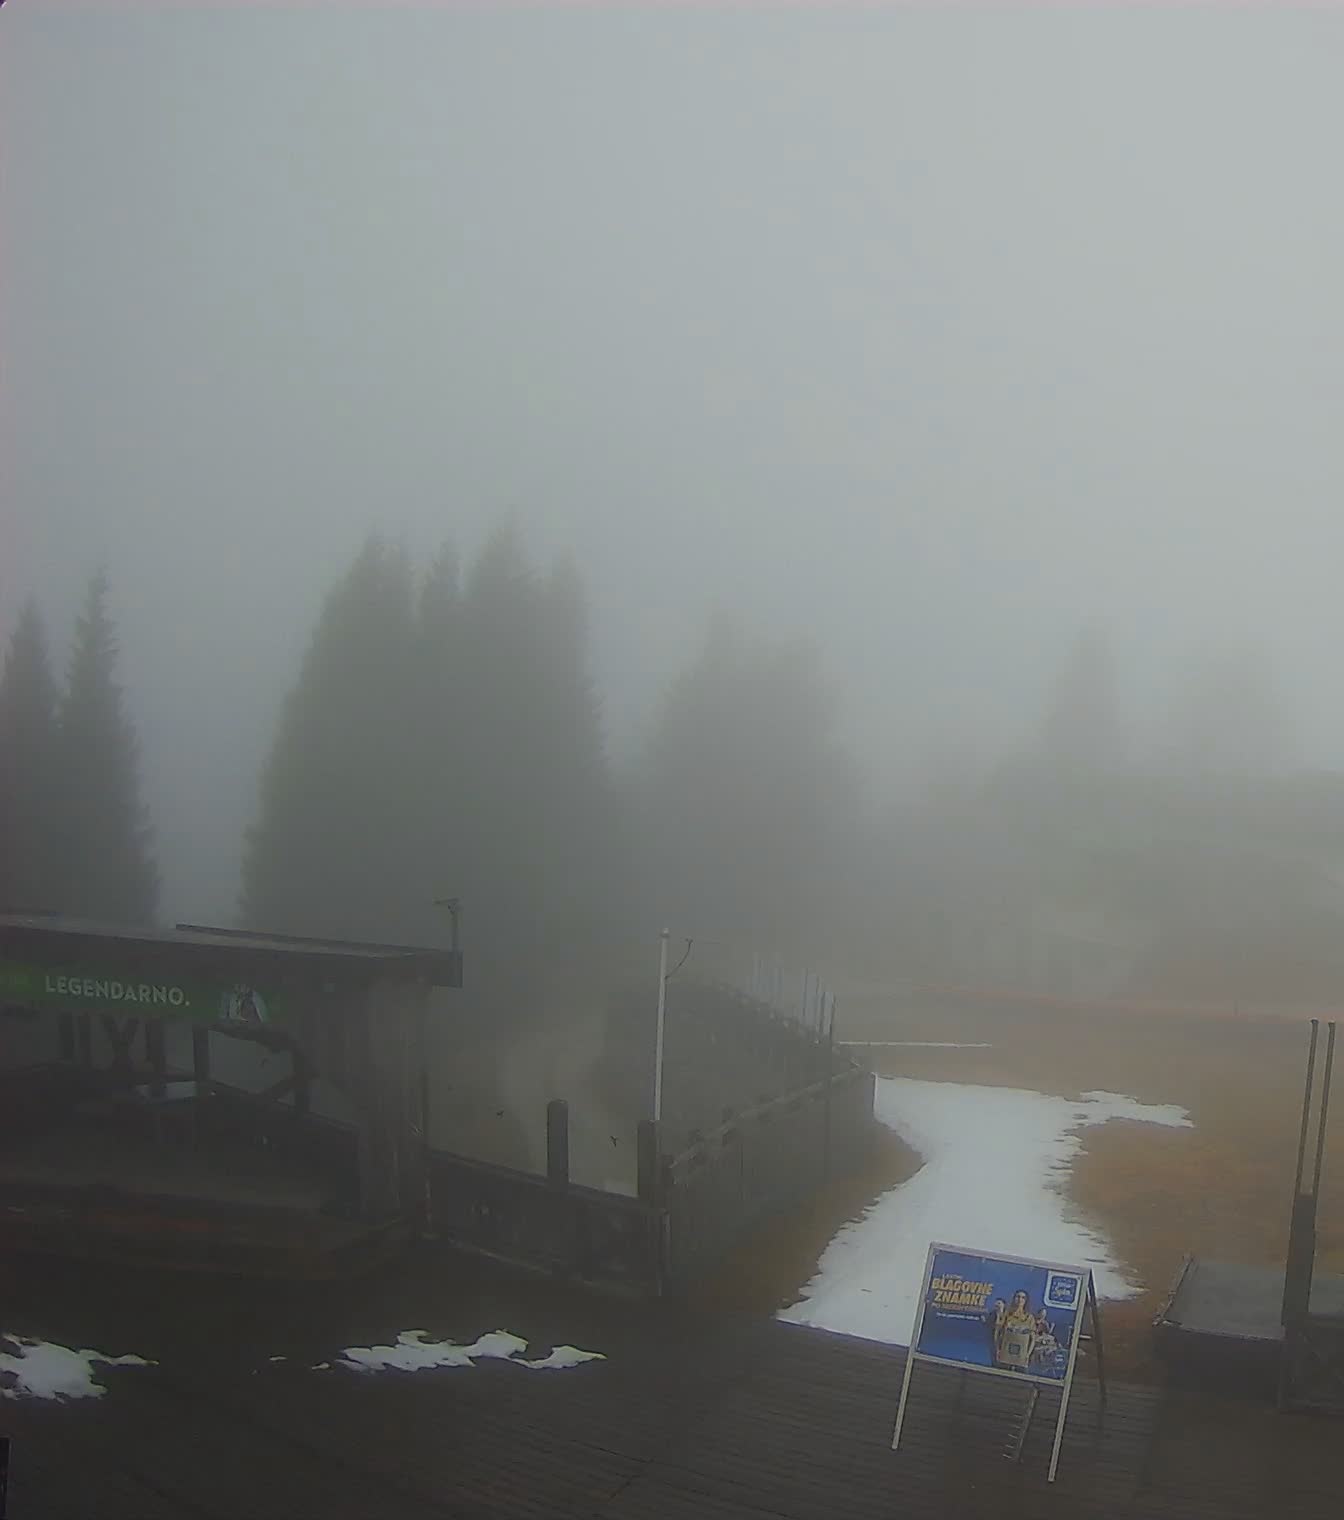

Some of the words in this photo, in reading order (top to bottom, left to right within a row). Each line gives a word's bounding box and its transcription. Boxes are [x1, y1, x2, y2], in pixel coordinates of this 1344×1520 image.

[45, 975, 190, 1006] LEGENDARNO.
[931, 1277, 993, 1295] BLAGOVNE
[934, 1290, 987, 1306] ZNAMKE
